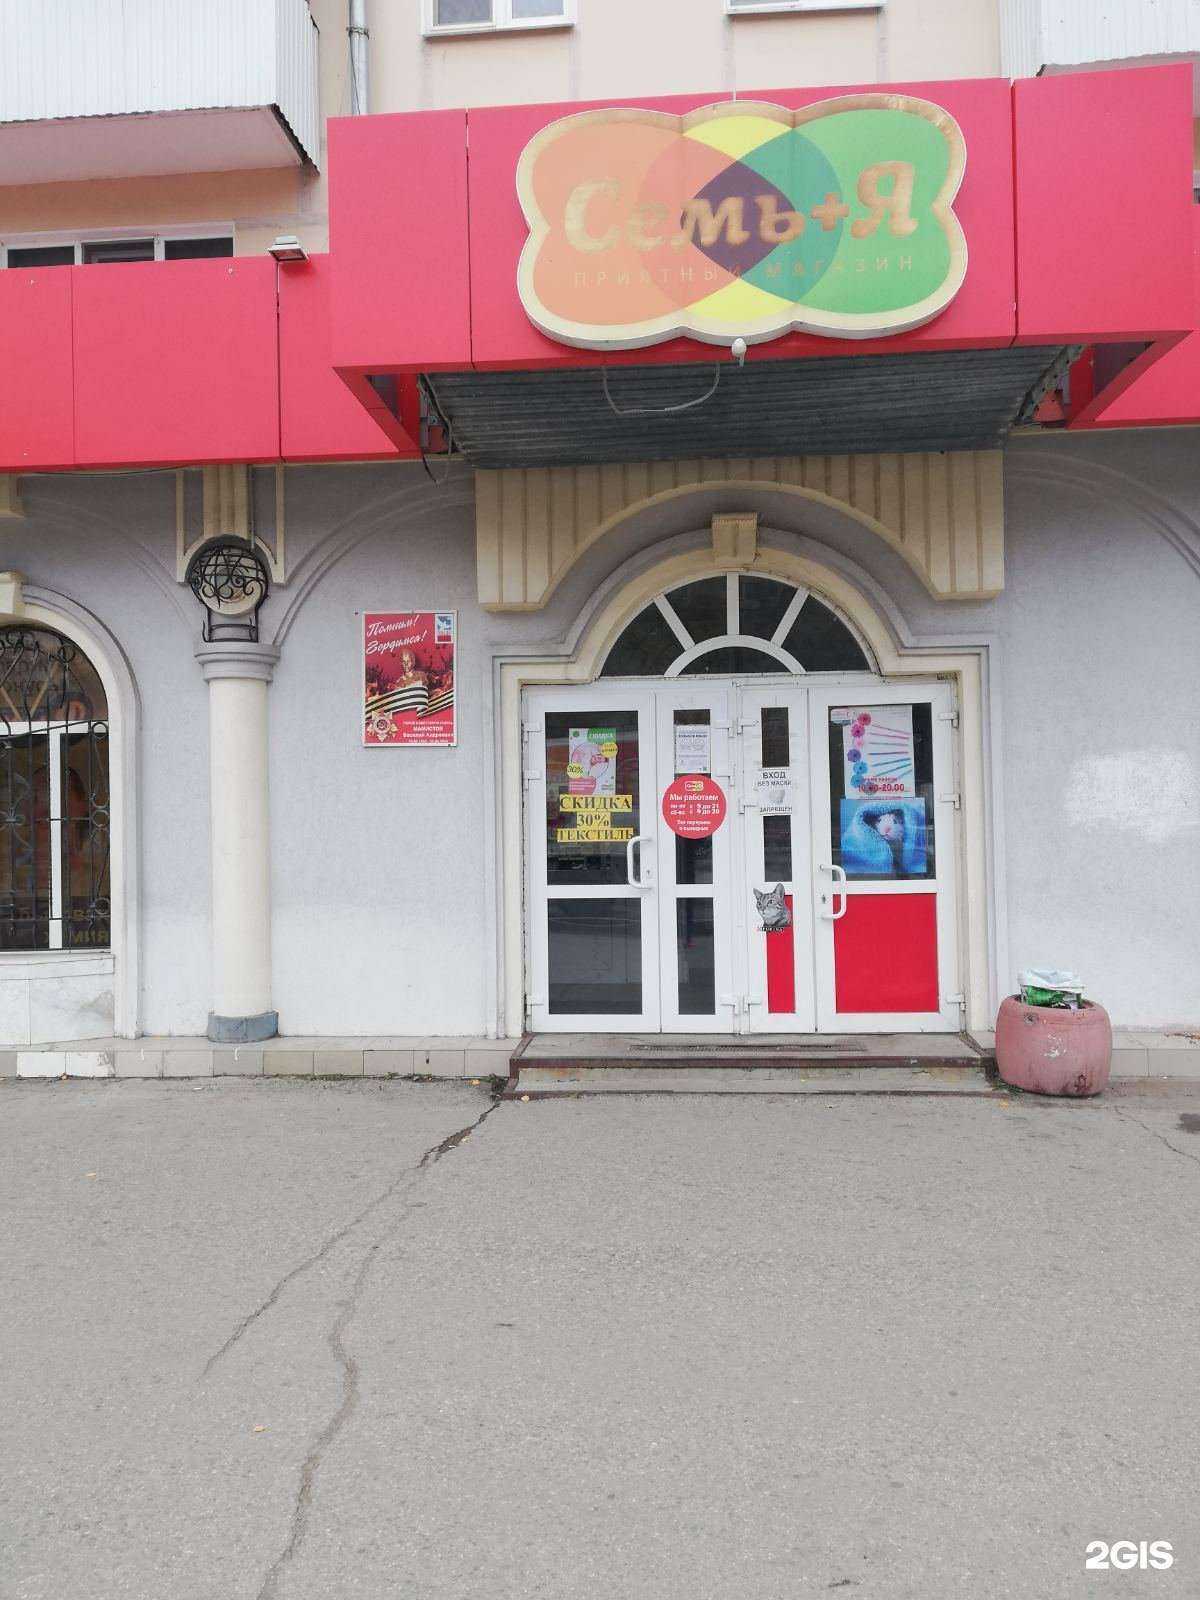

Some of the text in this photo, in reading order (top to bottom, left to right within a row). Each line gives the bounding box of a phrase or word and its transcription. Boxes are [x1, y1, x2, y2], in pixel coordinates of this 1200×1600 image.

[573, 256, 914, 289] ПРИЯТНЫЙ МАГАЗИН
[762, 771, 786, 779] ВХОД
[560, 796, 631, 812] СКИДКА
[577, 813, 610, 827] 30%
[557, 829, 633, 841] ТЕКСТИЛЬ
